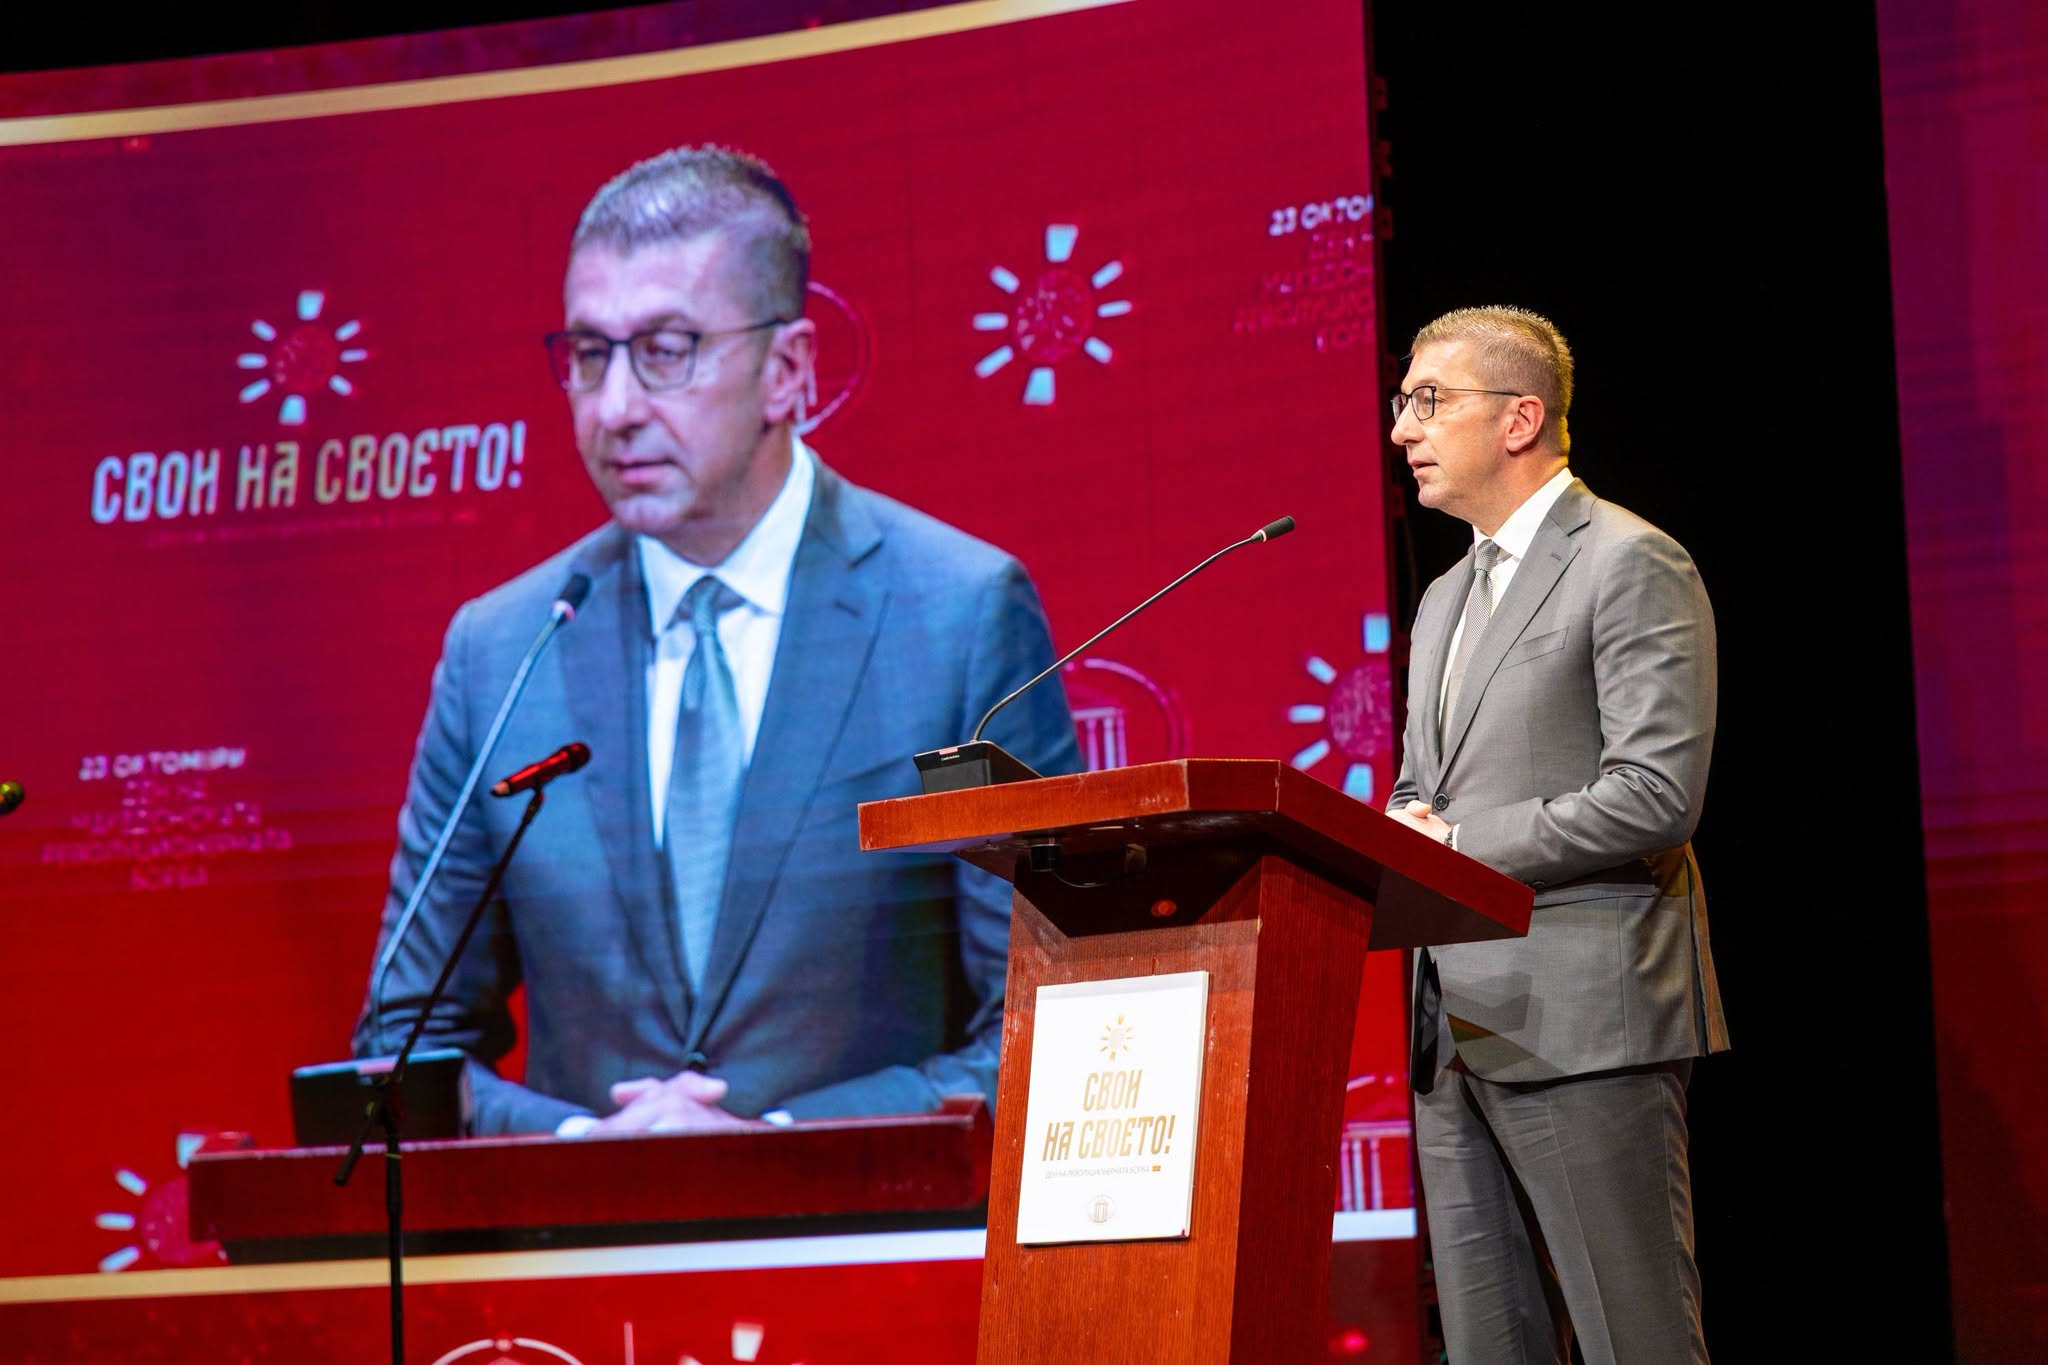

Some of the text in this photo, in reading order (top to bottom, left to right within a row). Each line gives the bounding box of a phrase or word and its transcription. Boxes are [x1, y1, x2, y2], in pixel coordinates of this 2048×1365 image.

[1269, 206, 1298, 237] 23
[91, 420, 528, 524] СВОИ НА СВОЕТО!
[1083, 1069, 1143, 1112] СВОИ
[1041, 1114, 1176, 1162] НА СВОЕТО!
